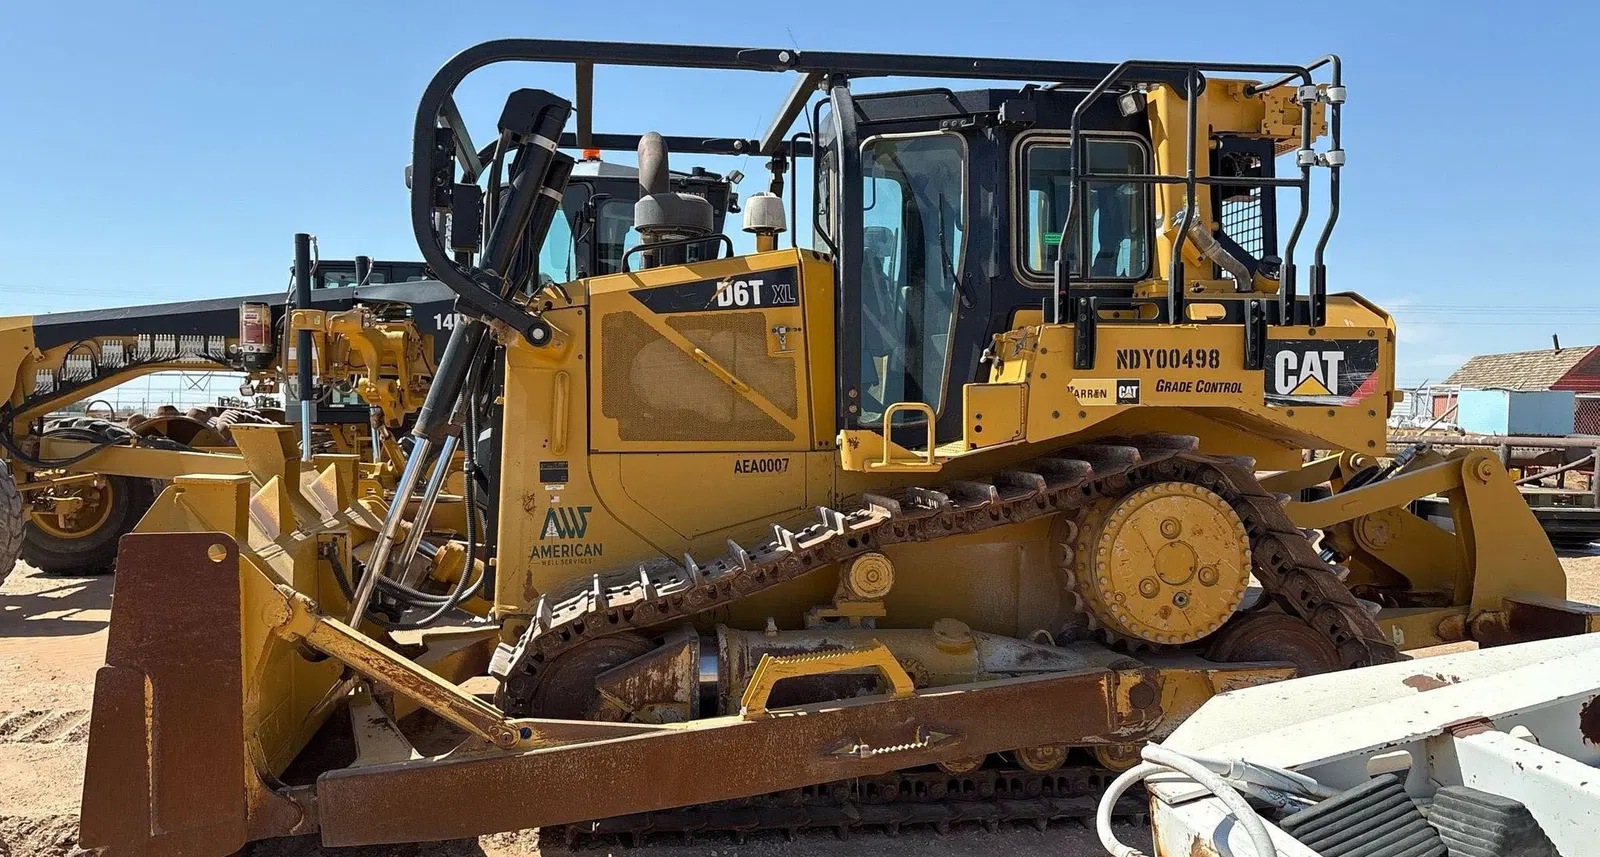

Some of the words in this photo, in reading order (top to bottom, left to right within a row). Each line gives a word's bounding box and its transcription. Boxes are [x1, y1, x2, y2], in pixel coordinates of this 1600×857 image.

[716, 279, 764, 307] D6T
[771, 284, 796, 304] XL
[1116, 348, 1220, 370] NDY00498
[1275, 349, 1345, 395] CAT
[1118, 385, 1139, 399] CAT
[734, 457, 790, 474] AEA0007
[530, 543, 603, 558] AMERICAN
[561, 558, 592, 566] SERVICES
